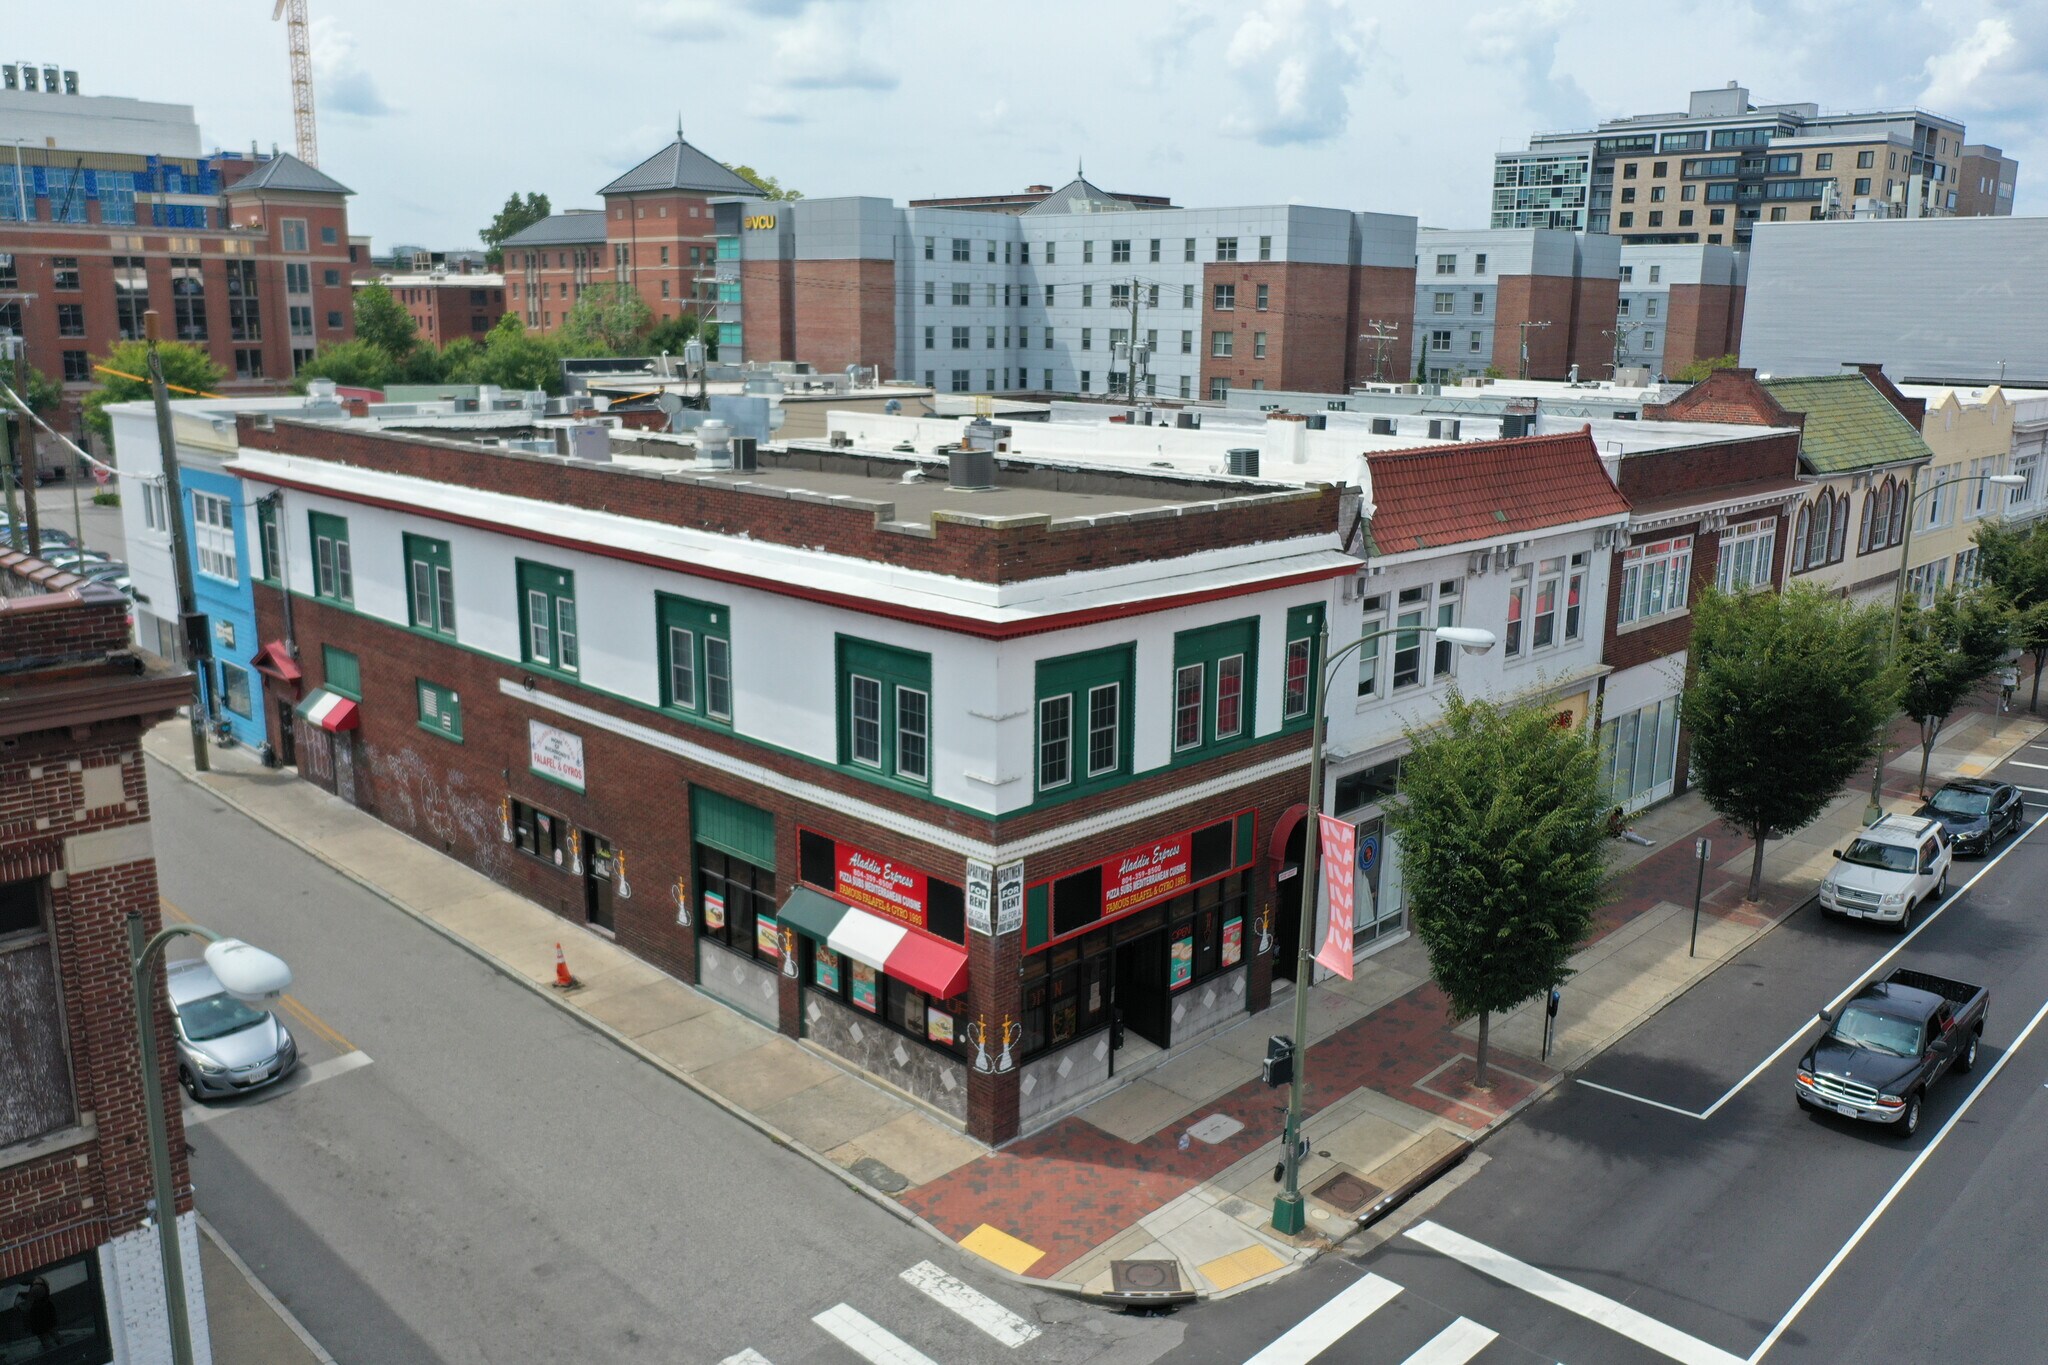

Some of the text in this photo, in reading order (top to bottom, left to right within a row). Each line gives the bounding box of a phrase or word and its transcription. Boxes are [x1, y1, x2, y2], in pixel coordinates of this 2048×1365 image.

[752, 215, 775, 230] VCU
[534, 752, 556, 769] FALAFEL
[563, 763, 583, 780] GYROS
[848, 852, 914, 888] Aladdin Express
[997, 862, 1024, 884] APARTMENT
[1118, 845, 1180, 879] Aladdin Express
[1132, 869, 1170, 891] MEDITERRANEAN
[1169, 862, 1187, 877] CUISINE
[840, 883, 862, 901] FAMOUS
[862, 892, 886, 911] FALAFEL
[891, 905, 909, 920] GYRO
[969, 894, 987, 910] RENT
[970, 885, 987, 897] FOR
[1002, 886, 1020, 898] FOR
[1105, 897, 1130, 914] FAMOUS
[1130, 887, 1153, 905] FALAFEL
[1158, 879, 1175, 893] GYRO
[902, 895, 922, 912] CUISINE
[1002, 895, 1020, 911] RENT
